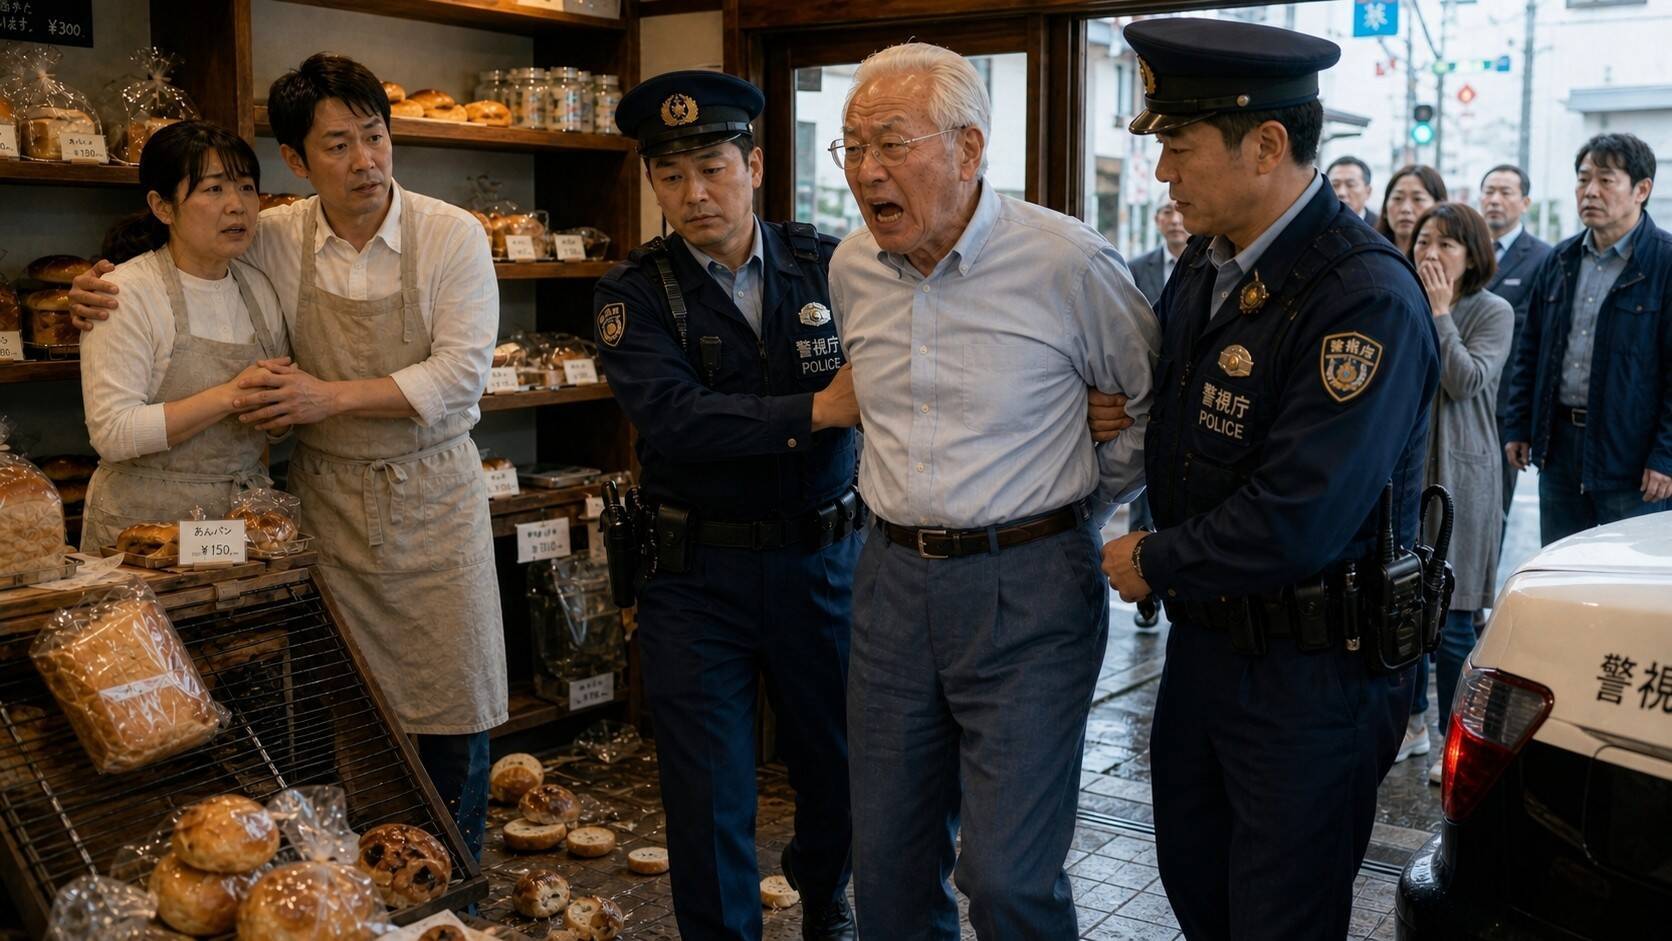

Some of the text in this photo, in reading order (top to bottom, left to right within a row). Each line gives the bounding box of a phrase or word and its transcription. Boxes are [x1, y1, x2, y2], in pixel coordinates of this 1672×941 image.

[801, 357, 841, 375] POLICE
[1202, 382, 1250, 419] 警視庁
[1199, 409, 1244, 440] POLICE
[1596, 652, 1672, 714] 警視
